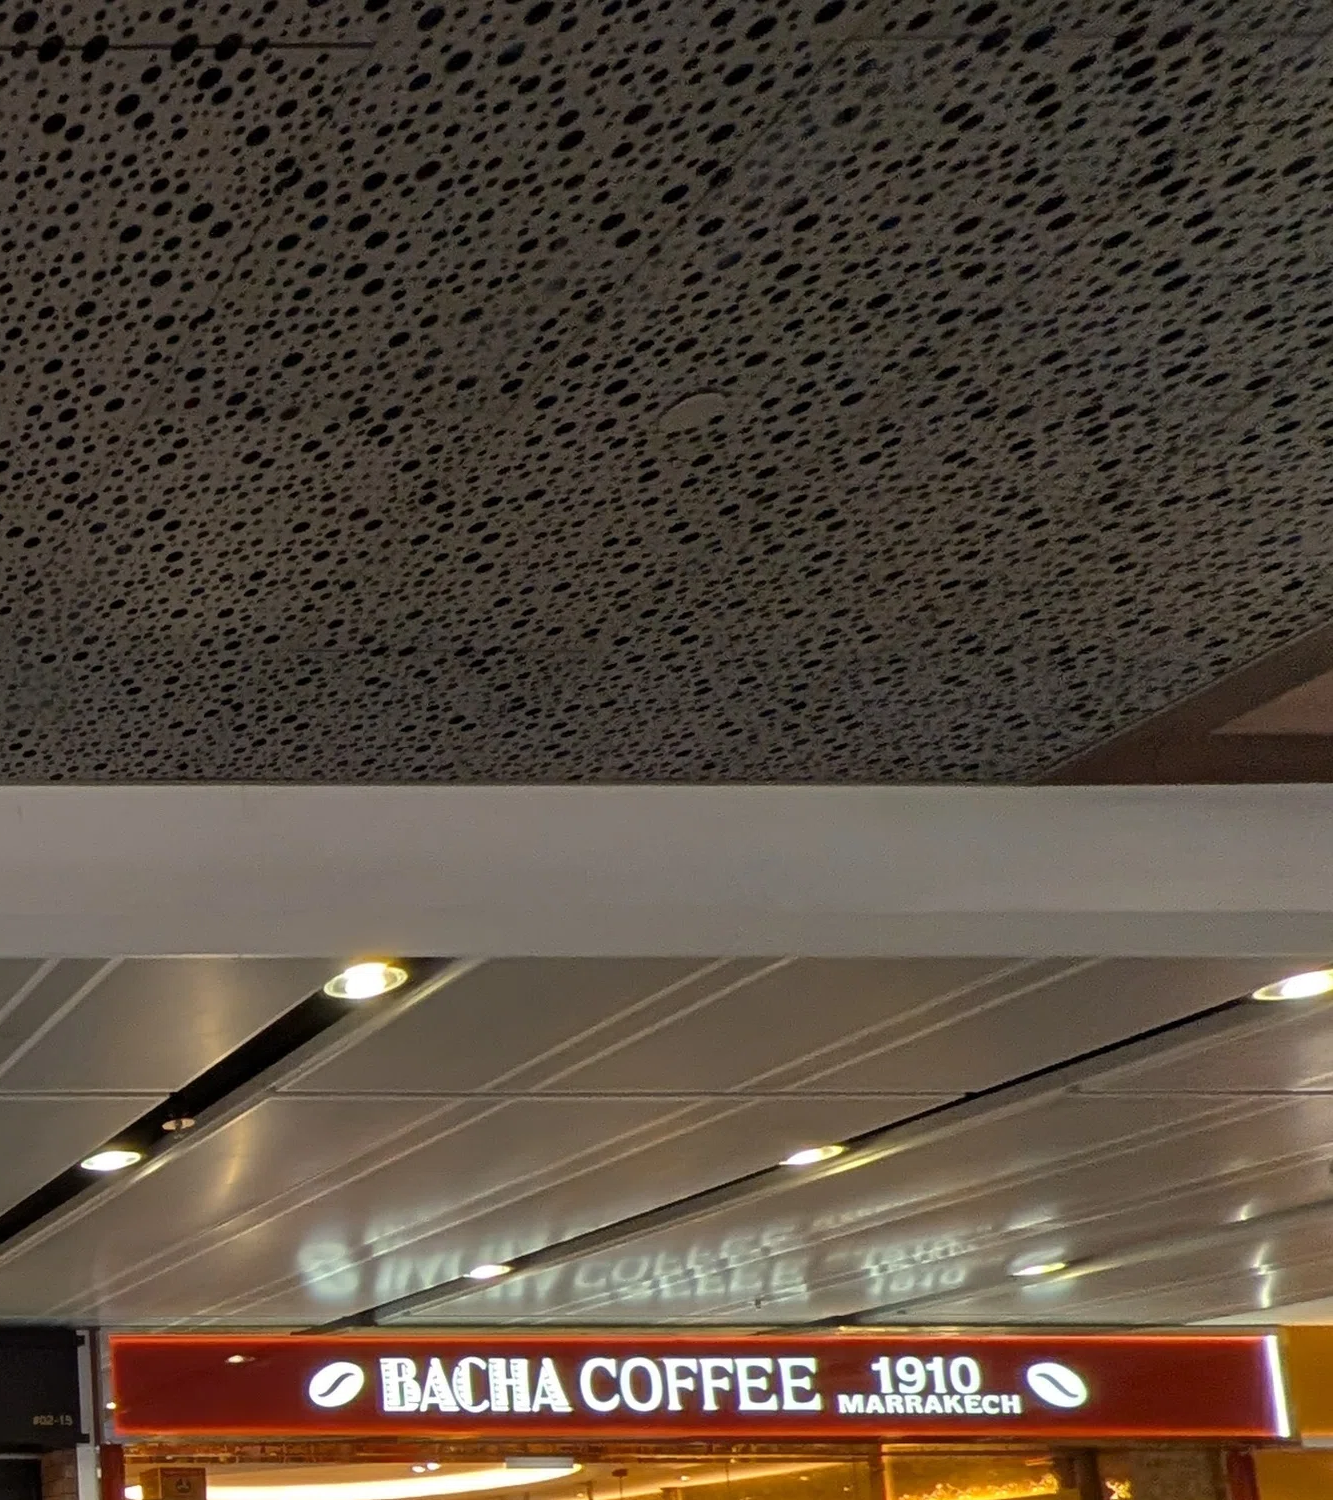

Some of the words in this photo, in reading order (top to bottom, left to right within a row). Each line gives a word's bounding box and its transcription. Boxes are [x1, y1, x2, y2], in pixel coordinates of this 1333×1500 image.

[379, 1357, 573, 1413] BACHA
[579, 1357, 823, 1413] COFFEE
[871, 1356, 981, 1394] 1910
[837, 1394, 1023, 1414] MARRAKECH
